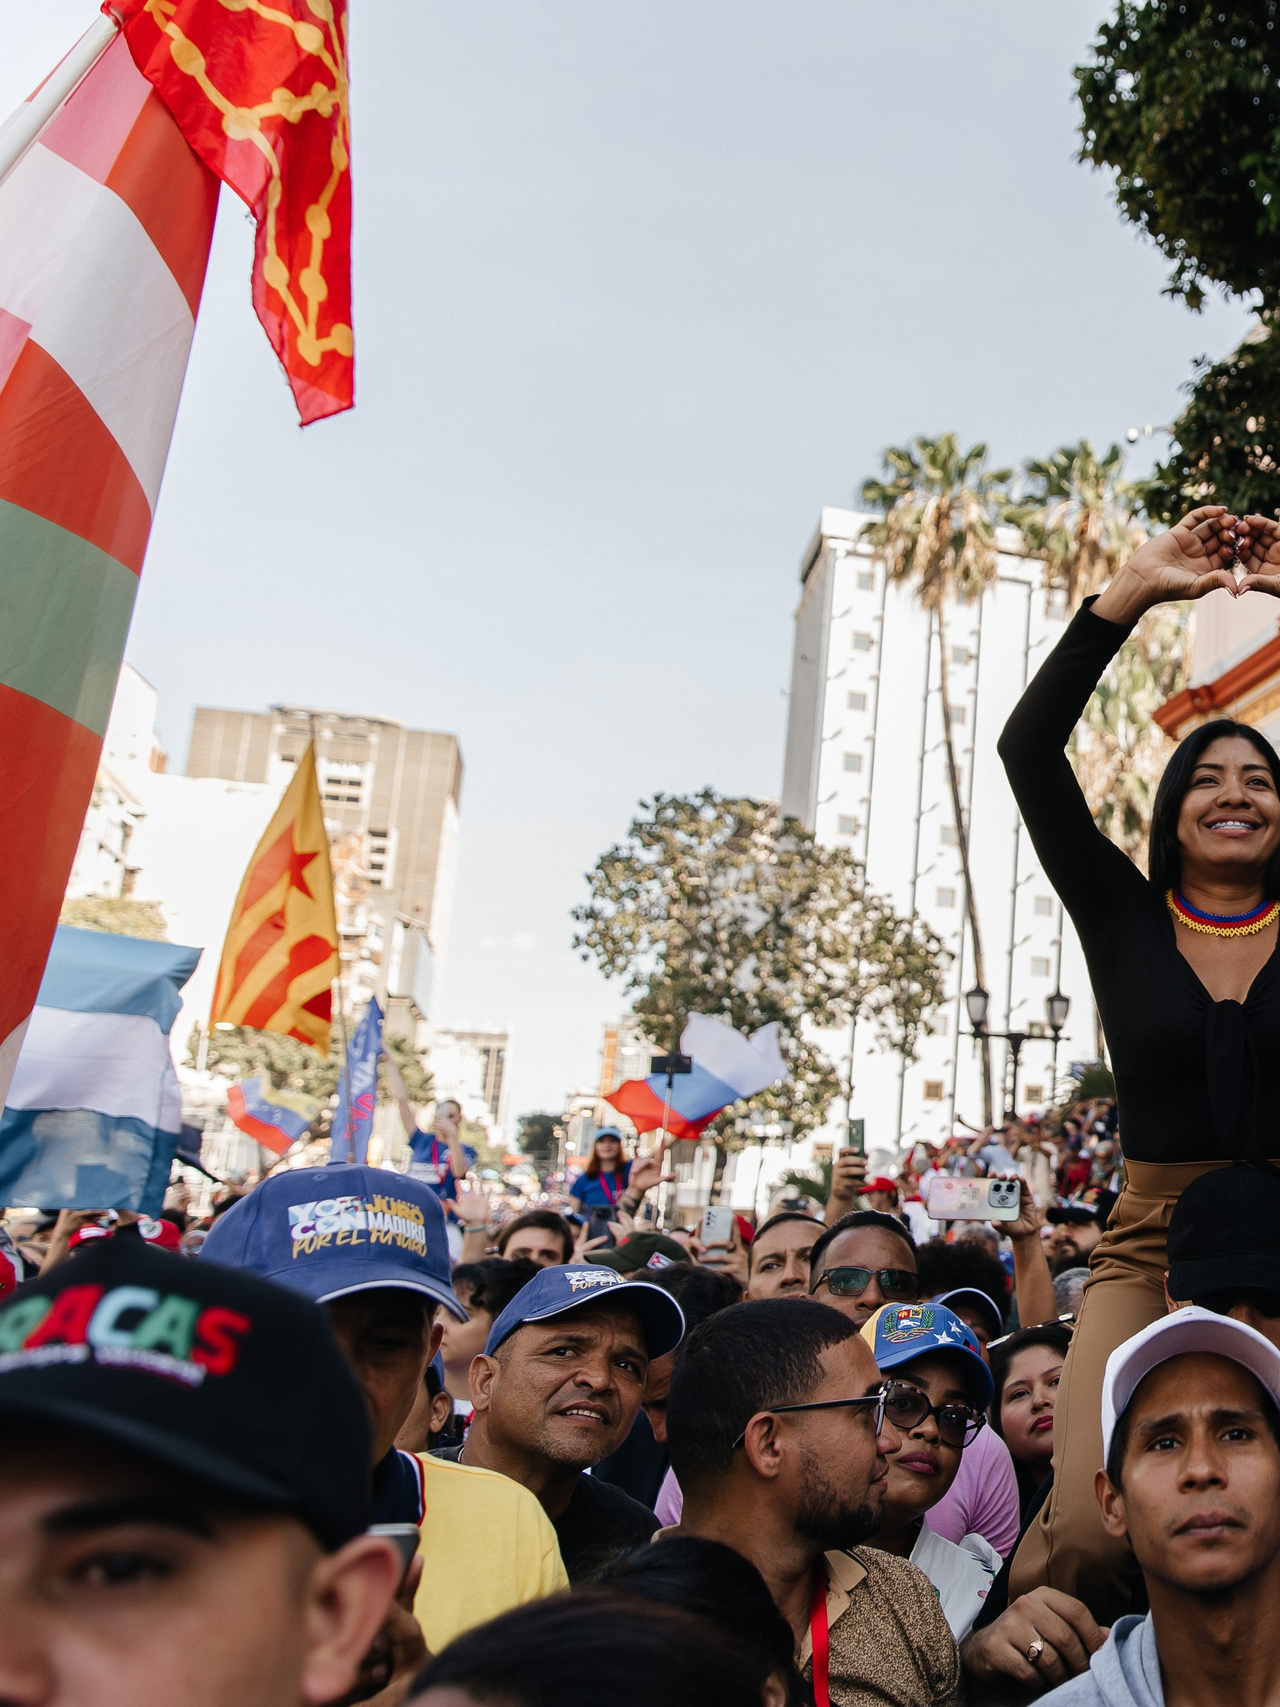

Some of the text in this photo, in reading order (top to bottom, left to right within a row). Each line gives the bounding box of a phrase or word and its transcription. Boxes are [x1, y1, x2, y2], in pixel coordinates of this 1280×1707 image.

[365, 1194, 425, 1225] JURO
[291, 1211, 426, 1244] CON MADURO
[292, 1232, 332, 1259] POR
[336, 1229, 366, 1246] EL
[571, 1281, 597, 1292] POR
